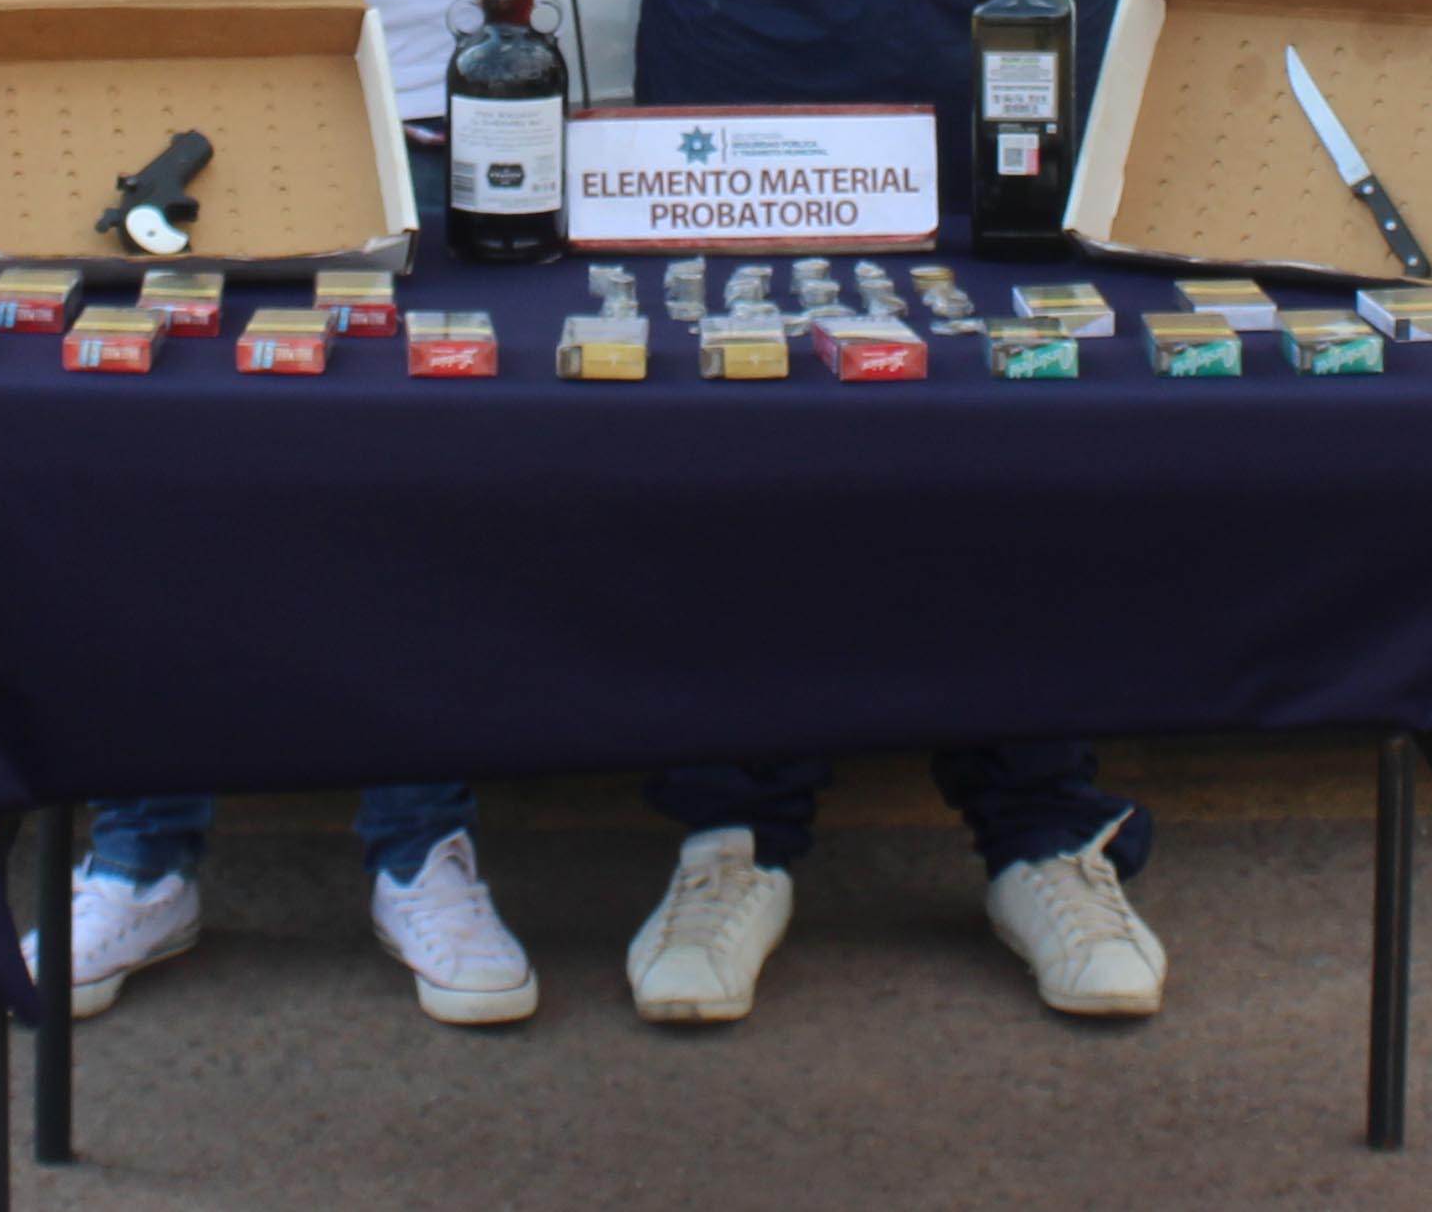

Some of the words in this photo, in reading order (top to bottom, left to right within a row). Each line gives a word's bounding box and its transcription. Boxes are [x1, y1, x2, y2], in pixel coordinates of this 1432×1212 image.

[581, 169, 752, 199] ELEMENTO
[759, 167, 920, 195] MATERIAL
[649, 199, 859, 229] PROBATORIO
